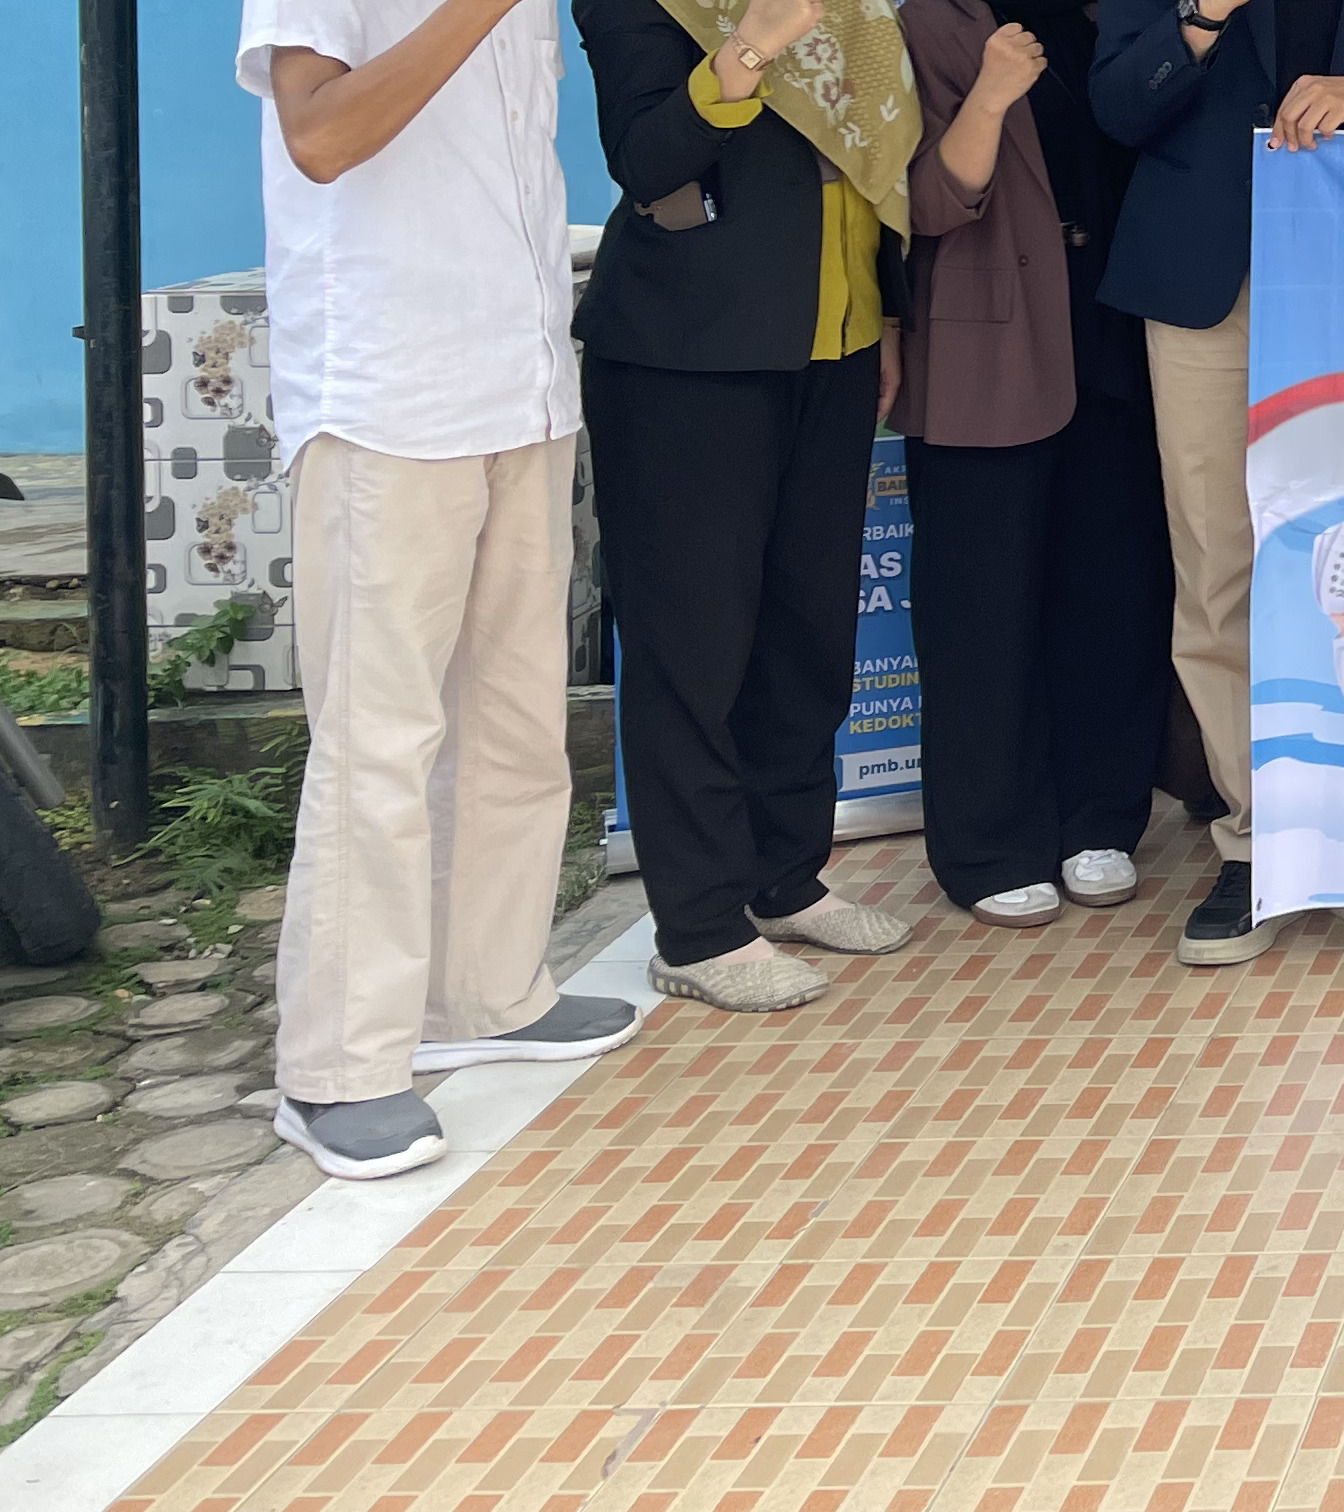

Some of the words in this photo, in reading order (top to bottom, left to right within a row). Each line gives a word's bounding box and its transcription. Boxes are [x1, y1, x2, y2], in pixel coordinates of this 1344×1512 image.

[877, 479, 907, 493] BAI
[862, 522, 915, 542] RBAIK
[852, 671, 920, 693] STUDIN
[850, 696, 913, 718] PUNYA
